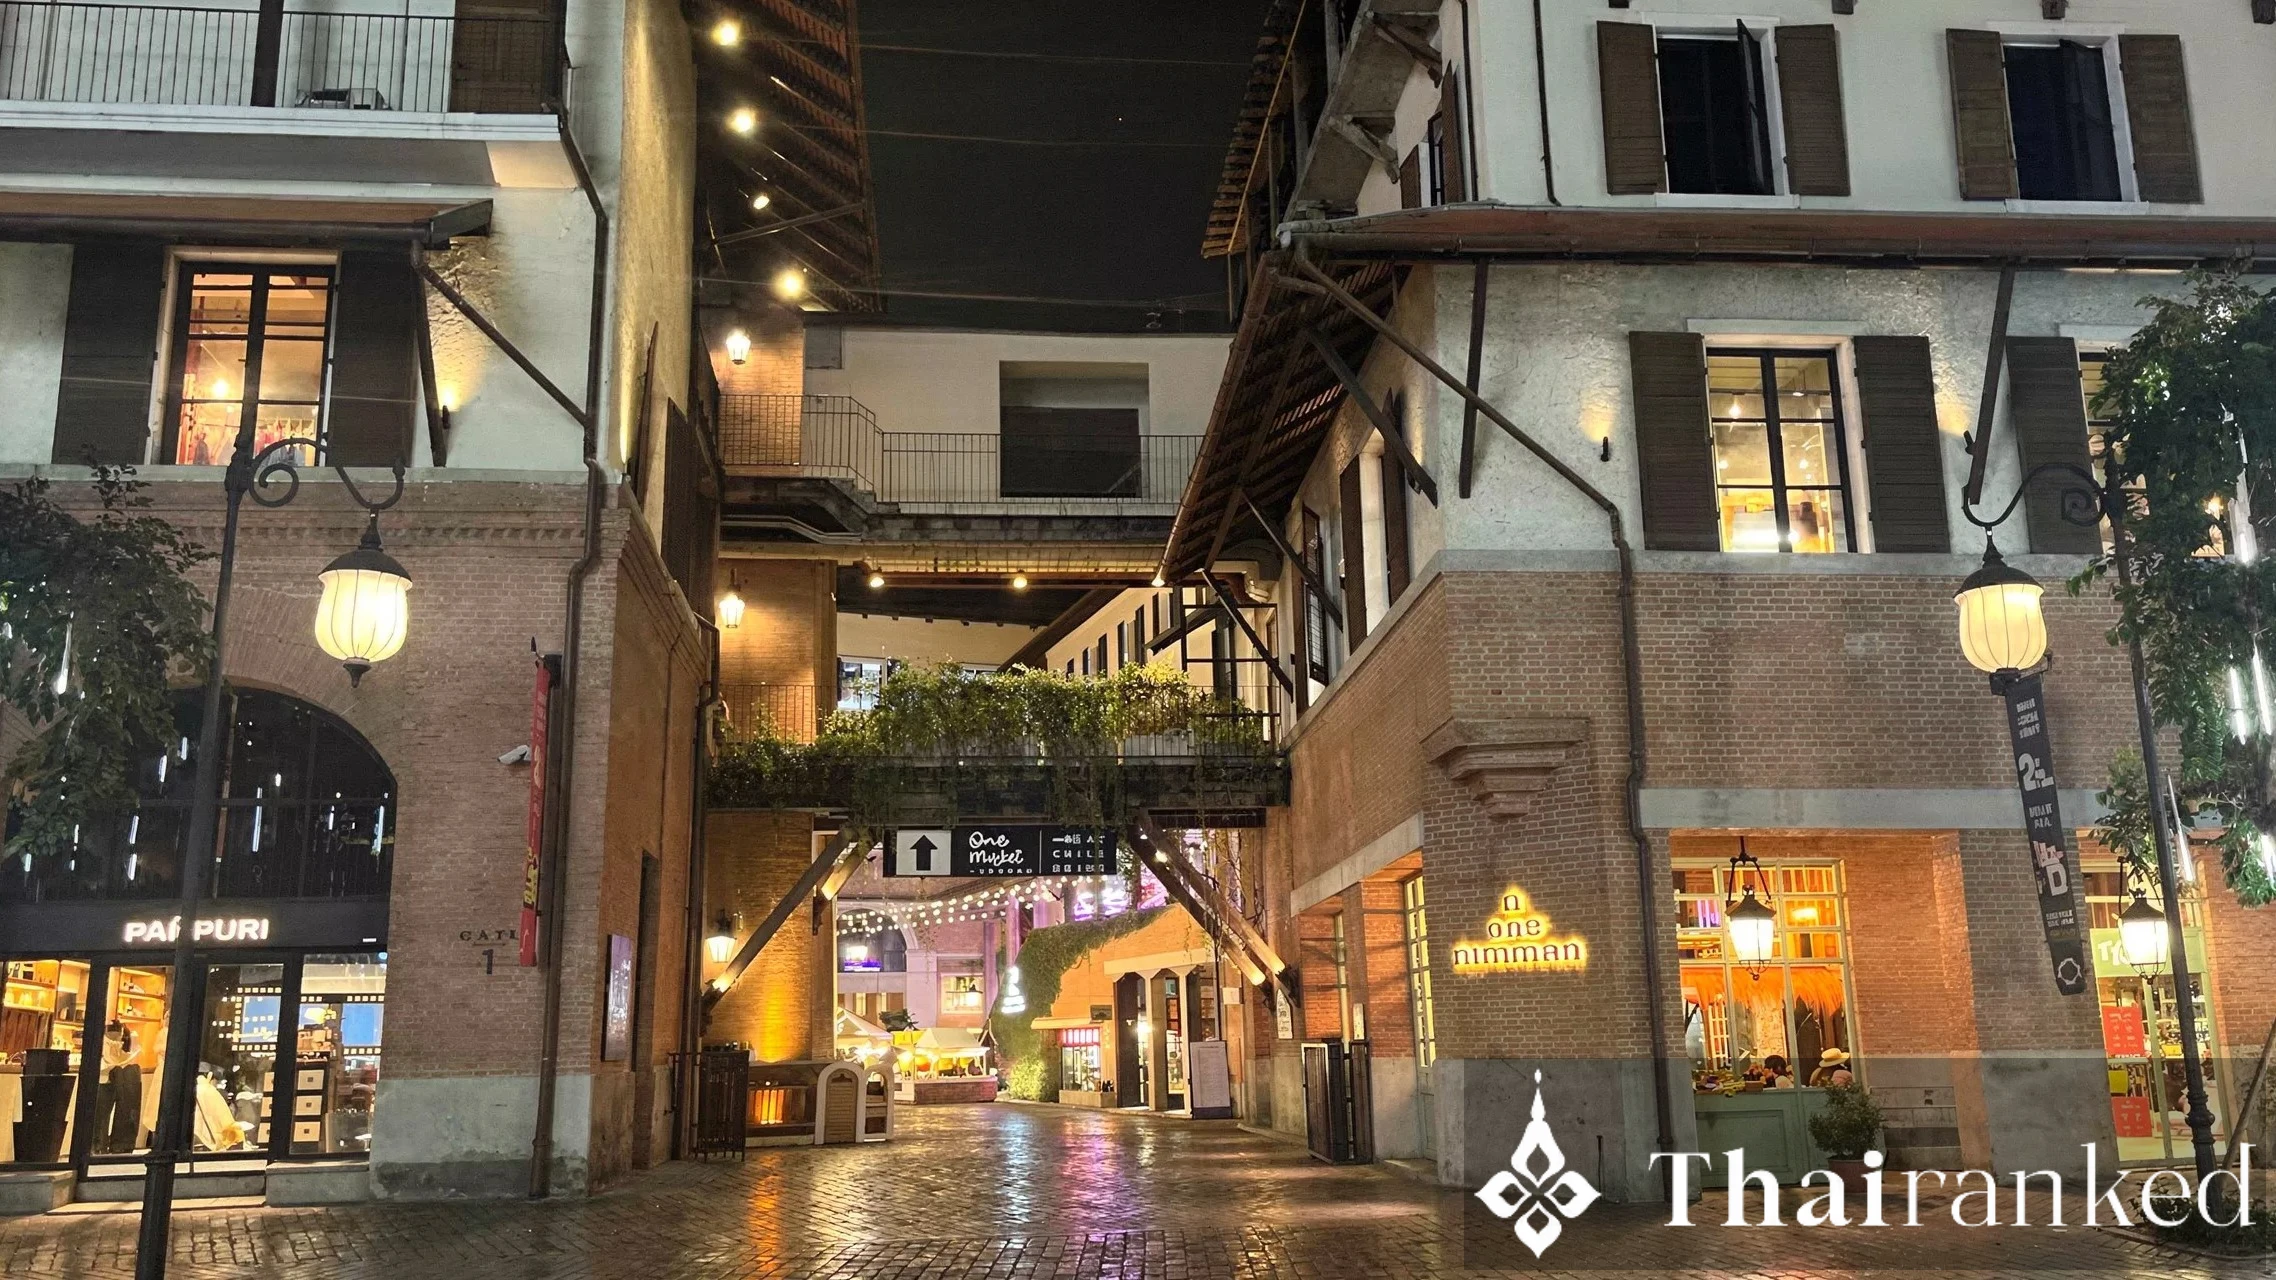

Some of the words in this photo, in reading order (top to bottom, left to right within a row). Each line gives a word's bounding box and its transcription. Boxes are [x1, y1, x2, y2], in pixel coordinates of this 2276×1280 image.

[969, 831, 1010, 849] One
[1503, 894, 1520, 911] n
[1488, 919, 1541, 938] one
[482, 948, 494, 975] 1
[1453, 942, 1580, 965] nimman
